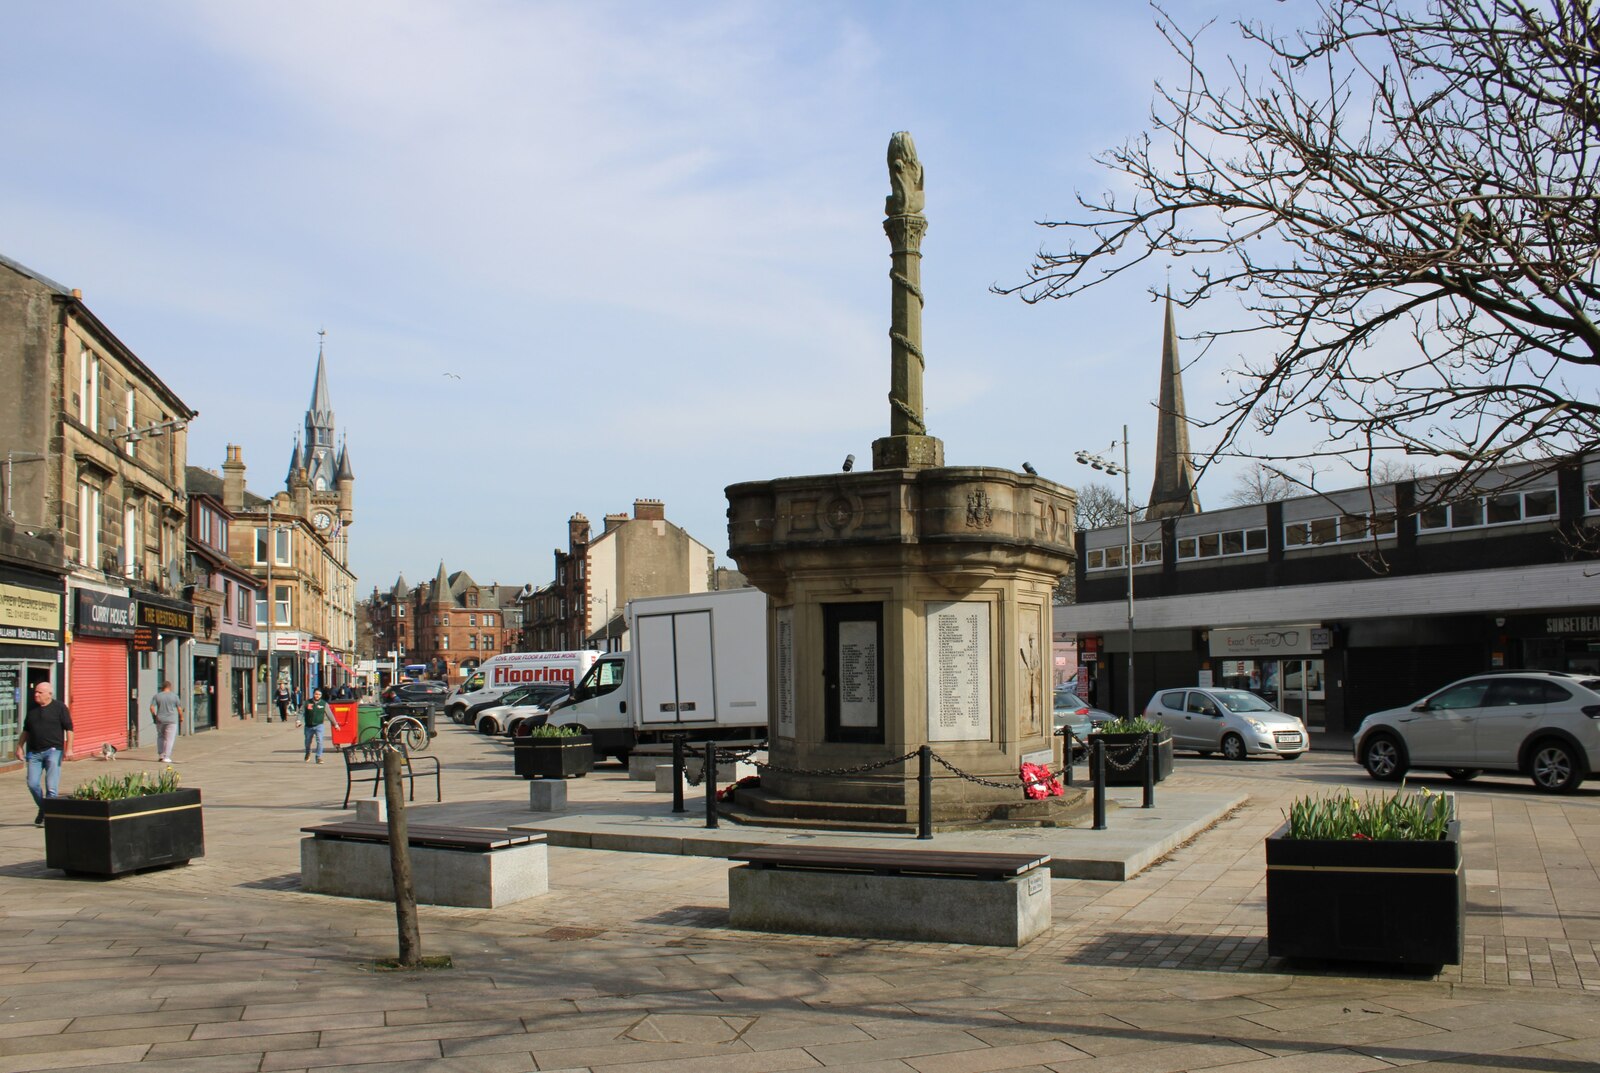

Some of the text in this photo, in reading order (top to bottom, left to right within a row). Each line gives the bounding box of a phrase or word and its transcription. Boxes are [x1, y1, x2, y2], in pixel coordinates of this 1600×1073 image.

[92, 605, 127, 625] CURRY HOUSE
[144, 607, 188, 629] THE WESTERN BAR
[1227, 636, 1276, 648] Exact Eyecare
[495, 666, 574, 684] Flooring
